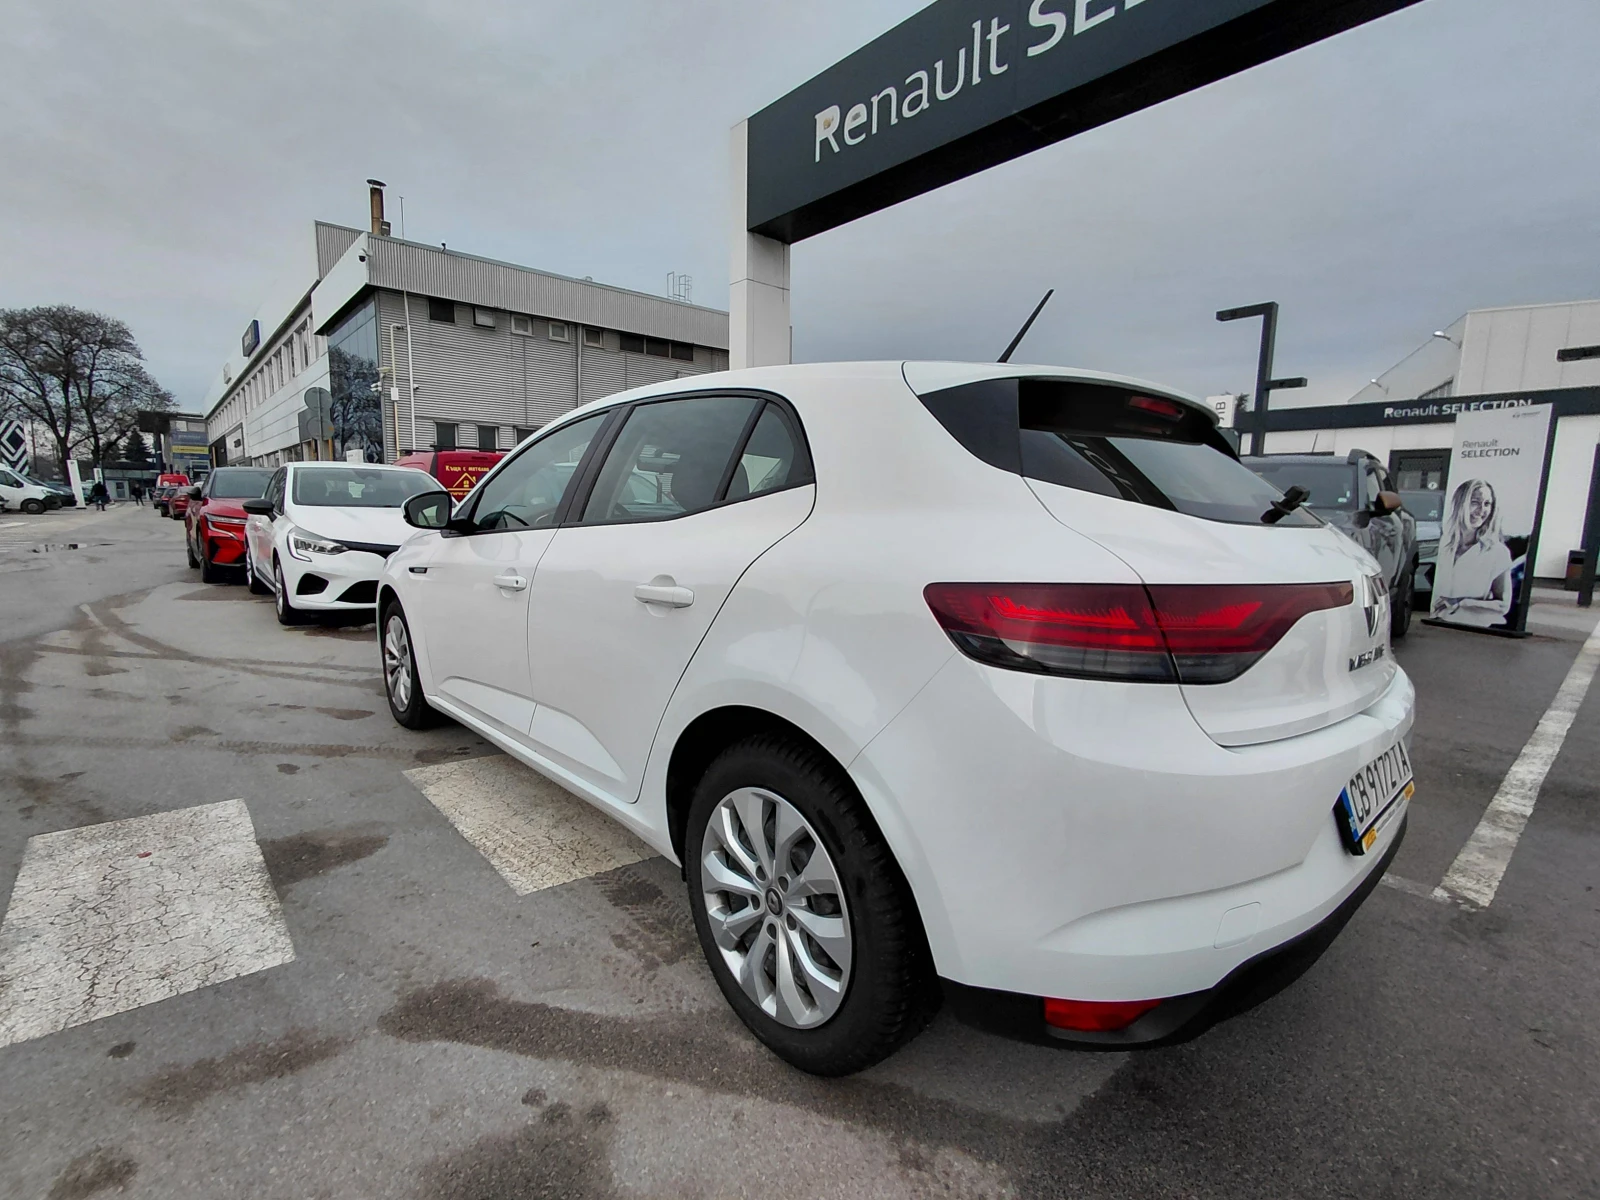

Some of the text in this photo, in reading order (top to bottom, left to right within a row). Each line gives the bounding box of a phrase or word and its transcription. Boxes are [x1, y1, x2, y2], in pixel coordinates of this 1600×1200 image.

[814, 16, 1010, 163] Renault
[1383, 405, 1440, 419] Renault
[1462, 438, 1499, 449] Renault
[1461, 447, 1521, 459] SELECTION
[1349, 772, 1371, 824] CB
[1366, 752, 1397, 807] 9172
[1389, 741, 1410, 780] TA
